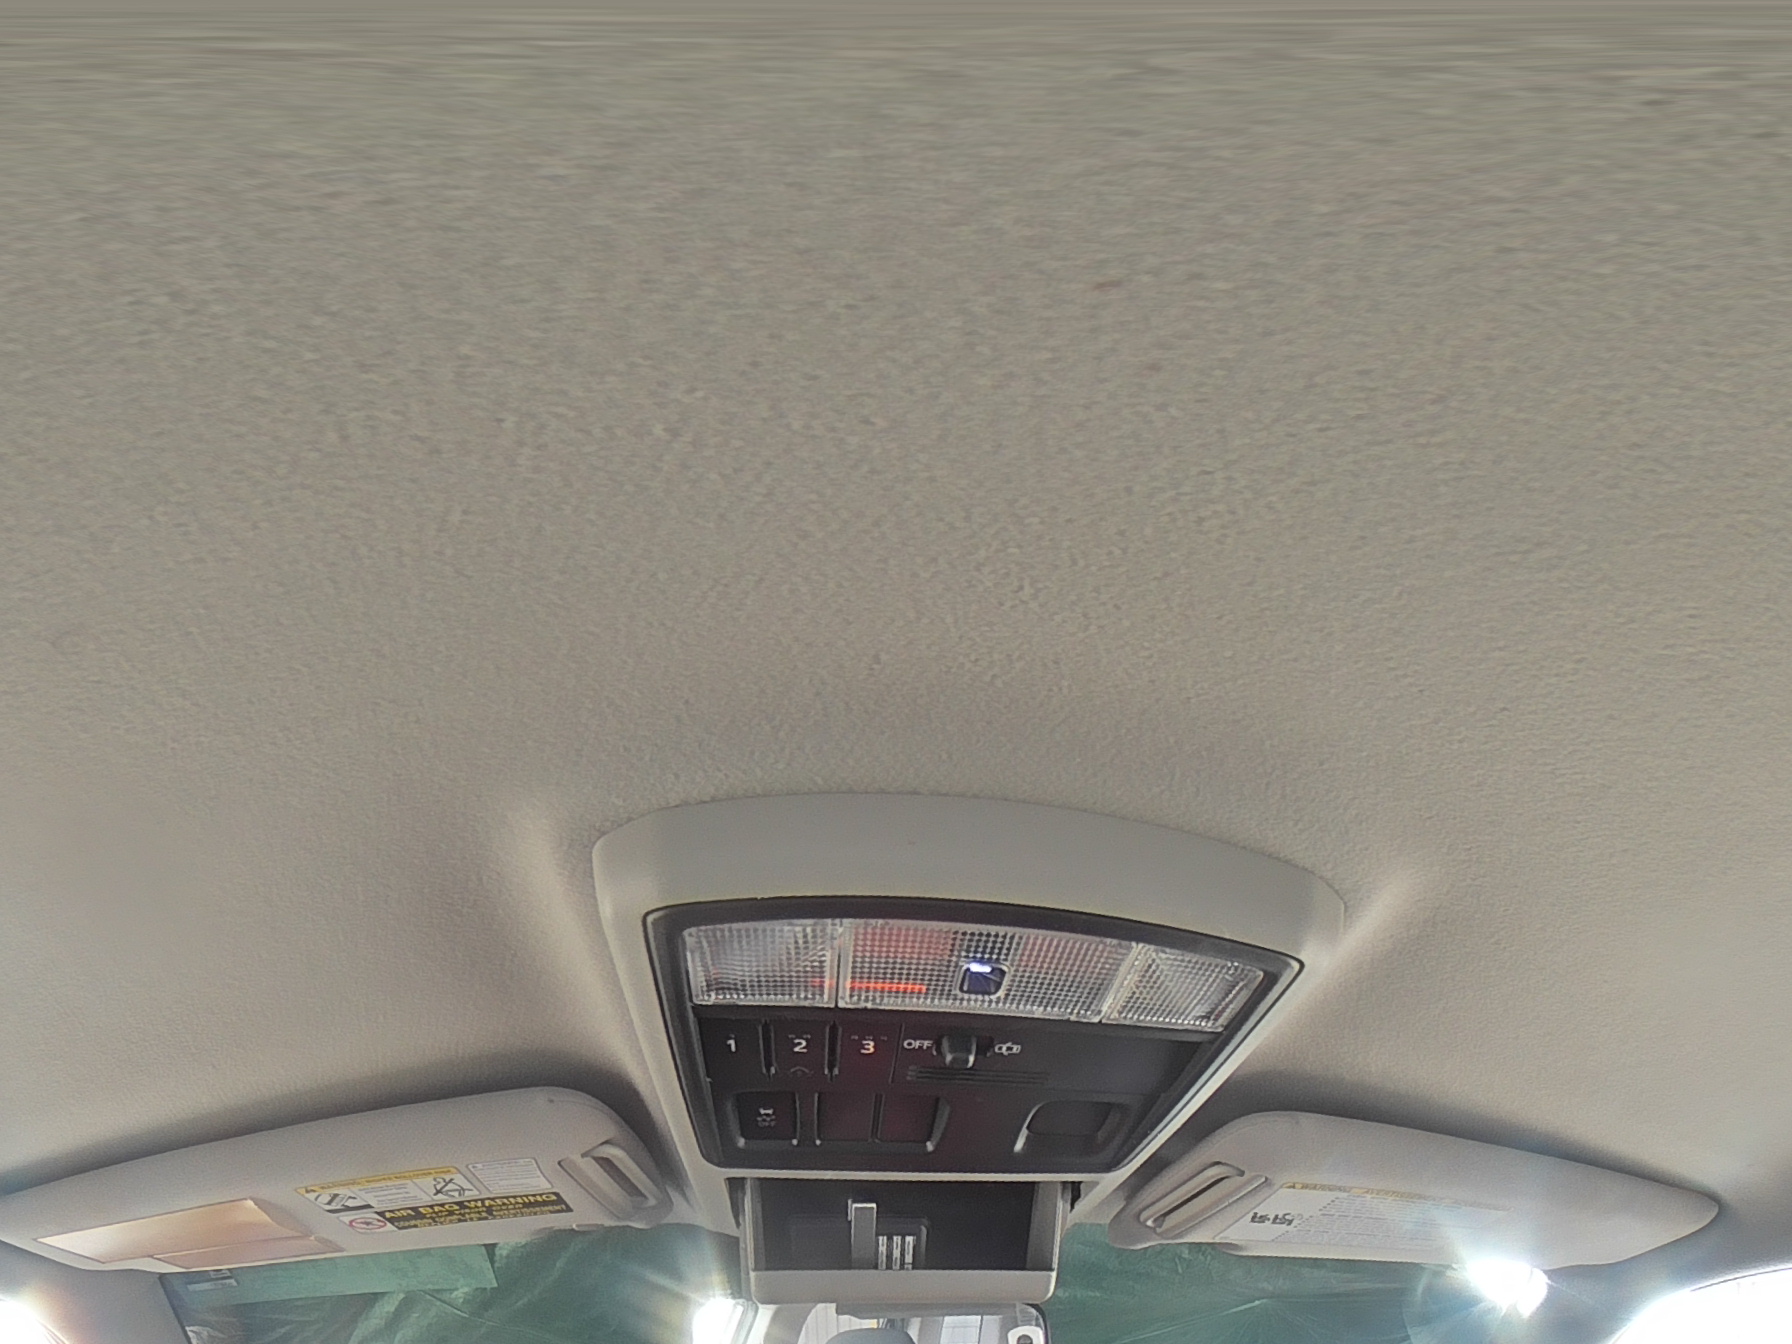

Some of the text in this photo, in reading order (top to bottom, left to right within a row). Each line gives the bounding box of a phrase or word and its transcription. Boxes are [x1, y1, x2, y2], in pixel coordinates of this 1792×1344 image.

[726, 1039, 737, 1052] 1
[793, 1039, 808, 1053] 2
[860, 1040, 875, 1054] 3
[903, 1039, 934, 1050] OFF
[384, 1193, 558, 1219] AIR BAG WARNING
